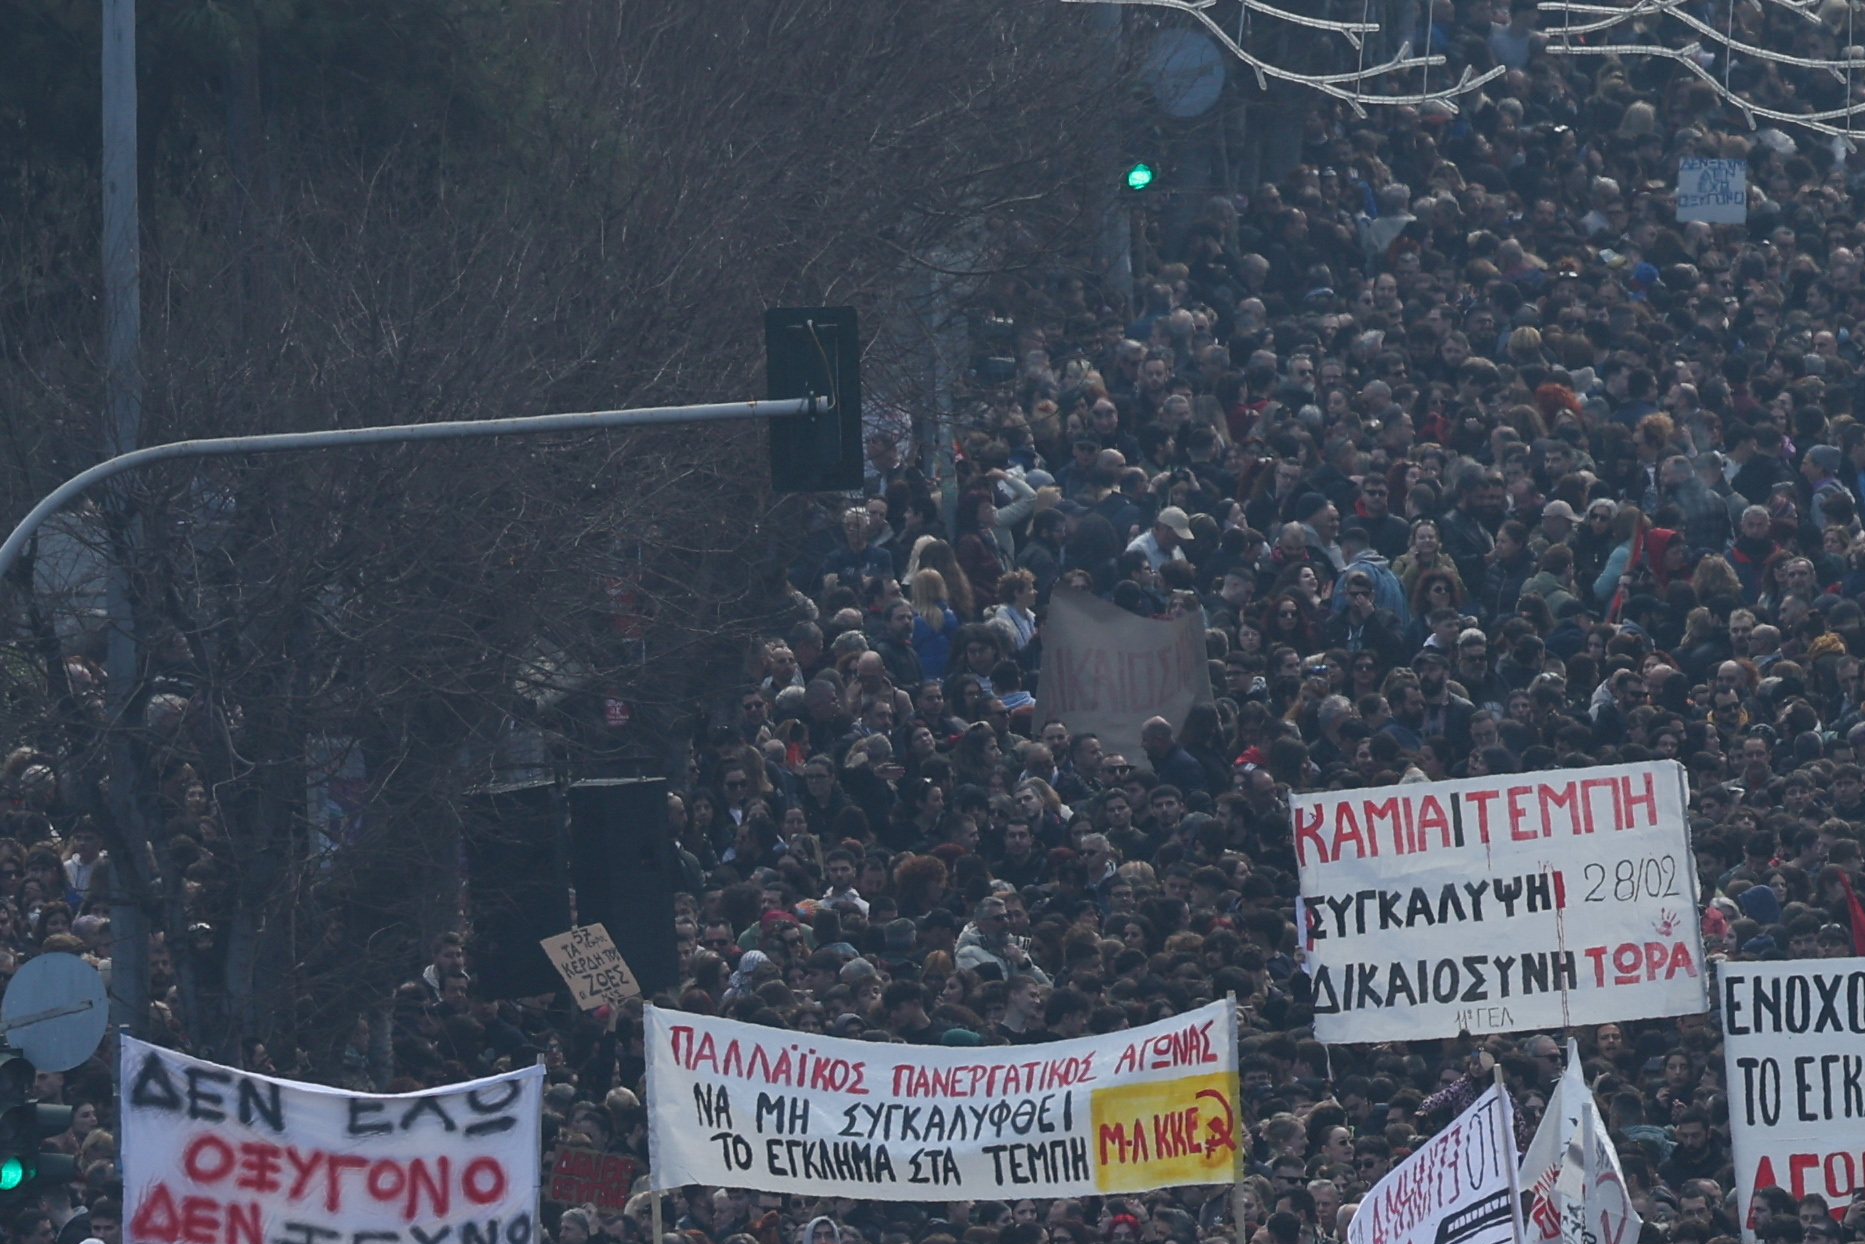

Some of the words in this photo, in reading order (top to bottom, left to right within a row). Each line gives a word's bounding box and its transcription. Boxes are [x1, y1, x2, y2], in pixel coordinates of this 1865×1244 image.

[1306, 871, 1554, 942] ΣΥΓΚΑΛΥΨΗ
[1583, 855, 1681, 903] 28/02
[561, 943, 581, 960] ΤΑ
[561, 952, 606, 980] ΚΕΡΔΗ
[1313, 950, 1577, 1015] ΔΙΚΑΙΟΣΥΝΗ
[1585, 941, 1698, 989] ΤΩΡΑ
[130, 1052, 283, 1131] ΔΕΝ
[892, 1051, 1096, 1097] ΠΑΝΕΡΓΑΤΙΚΟΣ
[1115, 1020, 1218, 1072] ΑΓΩΝΑΣ
[1736, 1056, 1782, 1125] ΤΟ
[694, 1084, 733, 1129] ΝΑ
[756, 1093, 809, 1136] ΜΗ
[839, 1088, 1073, 1142] ΣΥΓΚΑΛΥΦΘΕΙ
[1152, 1107, 1200, 1157] ΚΚΕ
[184, 1134, 508, 1225] ΟΞΥΓΟΝΟ
[710, 1136, 752, 1172] ΤΟ
[767, 1140, 895, 1183] ΕΓΚΛΗΜΑ
[907, 1147, 962, 1186] ΣΤΑ
[982, 1138, 1089, 1184] ΤΕΜΠΗ
